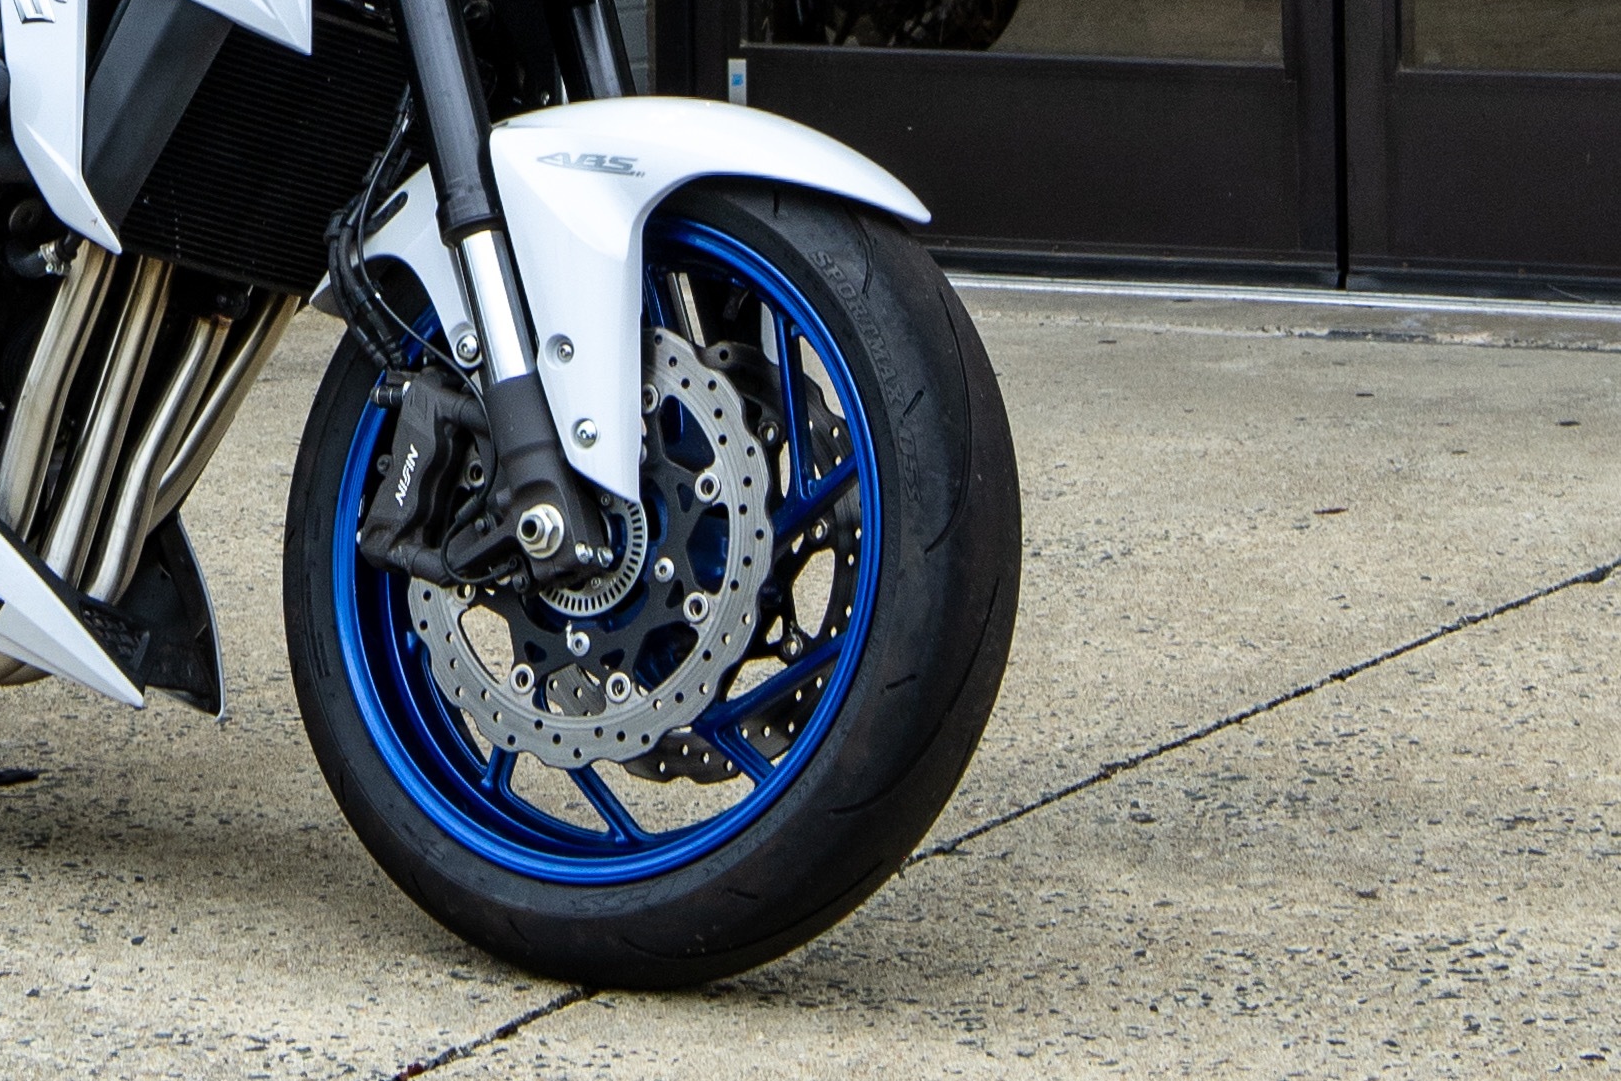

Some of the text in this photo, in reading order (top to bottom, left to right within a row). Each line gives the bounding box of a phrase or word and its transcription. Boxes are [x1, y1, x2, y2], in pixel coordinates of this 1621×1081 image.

[537, 151, 638, 176] ABS
[808, 250, 907, 407] SPORTMAX
[395, 443, 419, 507] NISSIN
